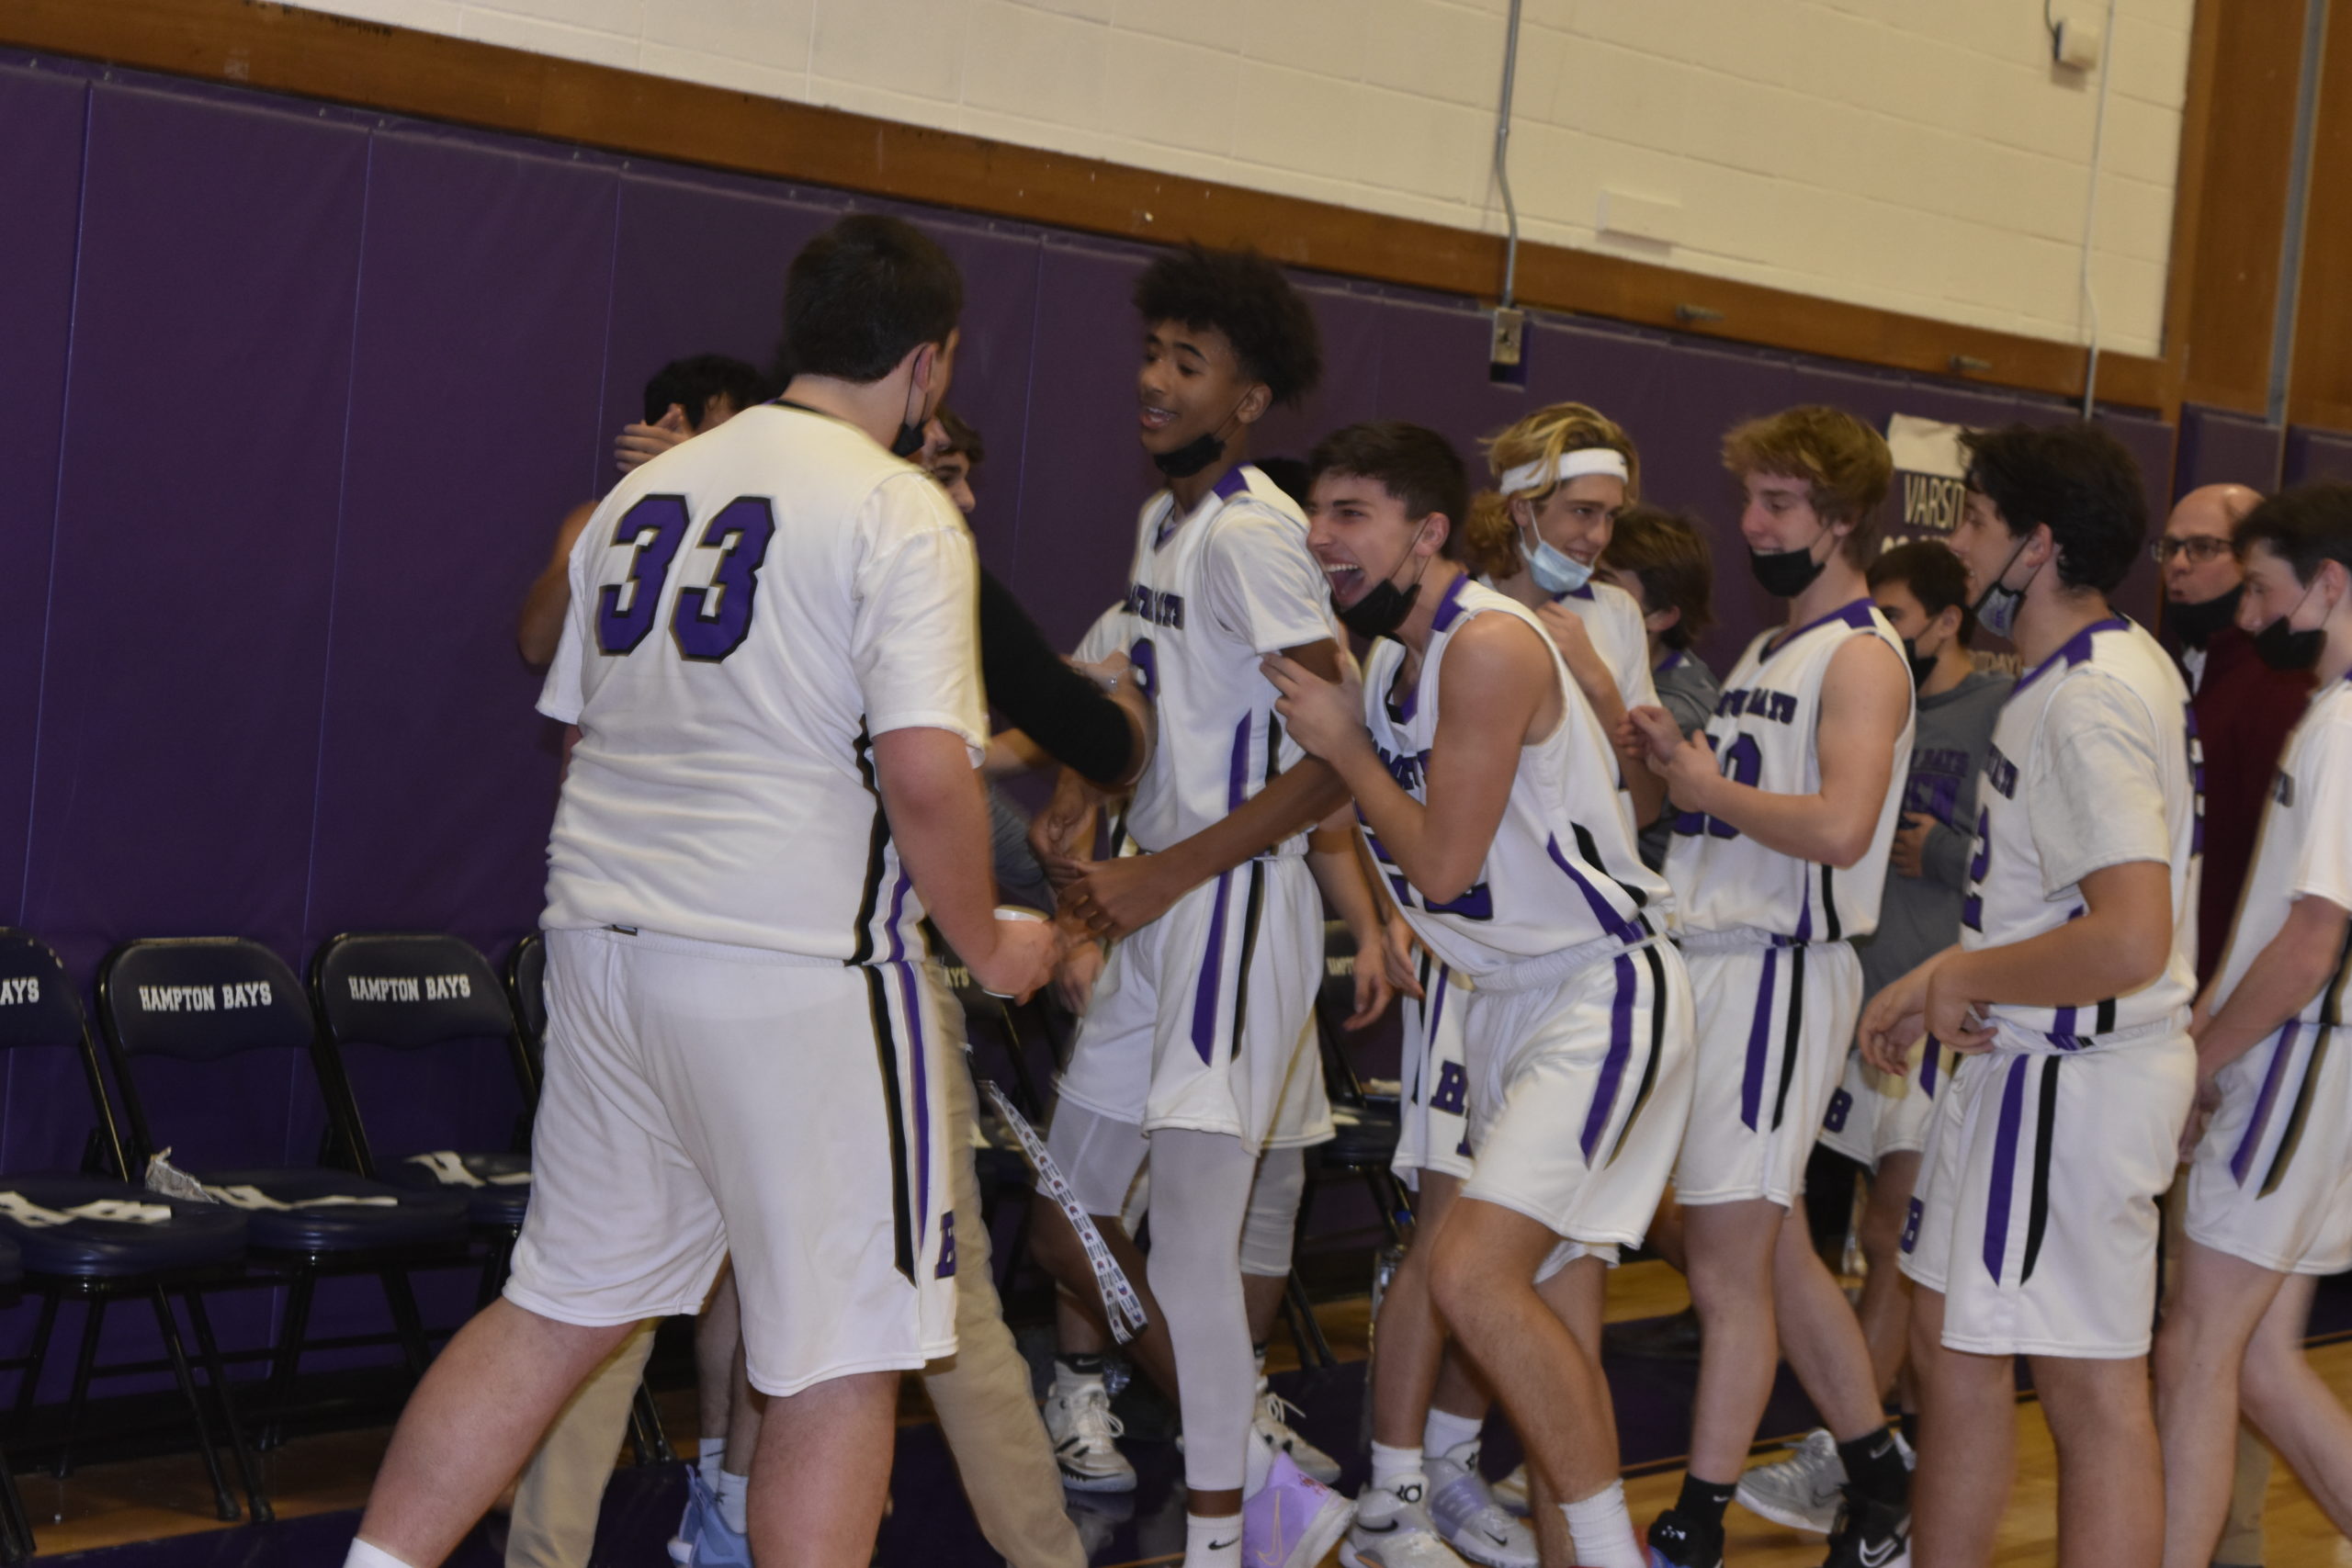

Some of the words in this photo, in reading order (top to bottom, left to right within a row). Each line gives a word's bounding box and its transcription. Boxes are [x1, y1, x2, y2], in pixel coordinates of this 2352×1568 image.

[1904, 473, 1966, 530] VARSIT
[594, 493, 775, 664] 33
[139, 985, 216, 1011] HAMPTON
[222, 980, 272, 1010] BAYS
[348, 975, 419, 1001] HAMPTON
[425, 974, 471, 1000] BAYS
